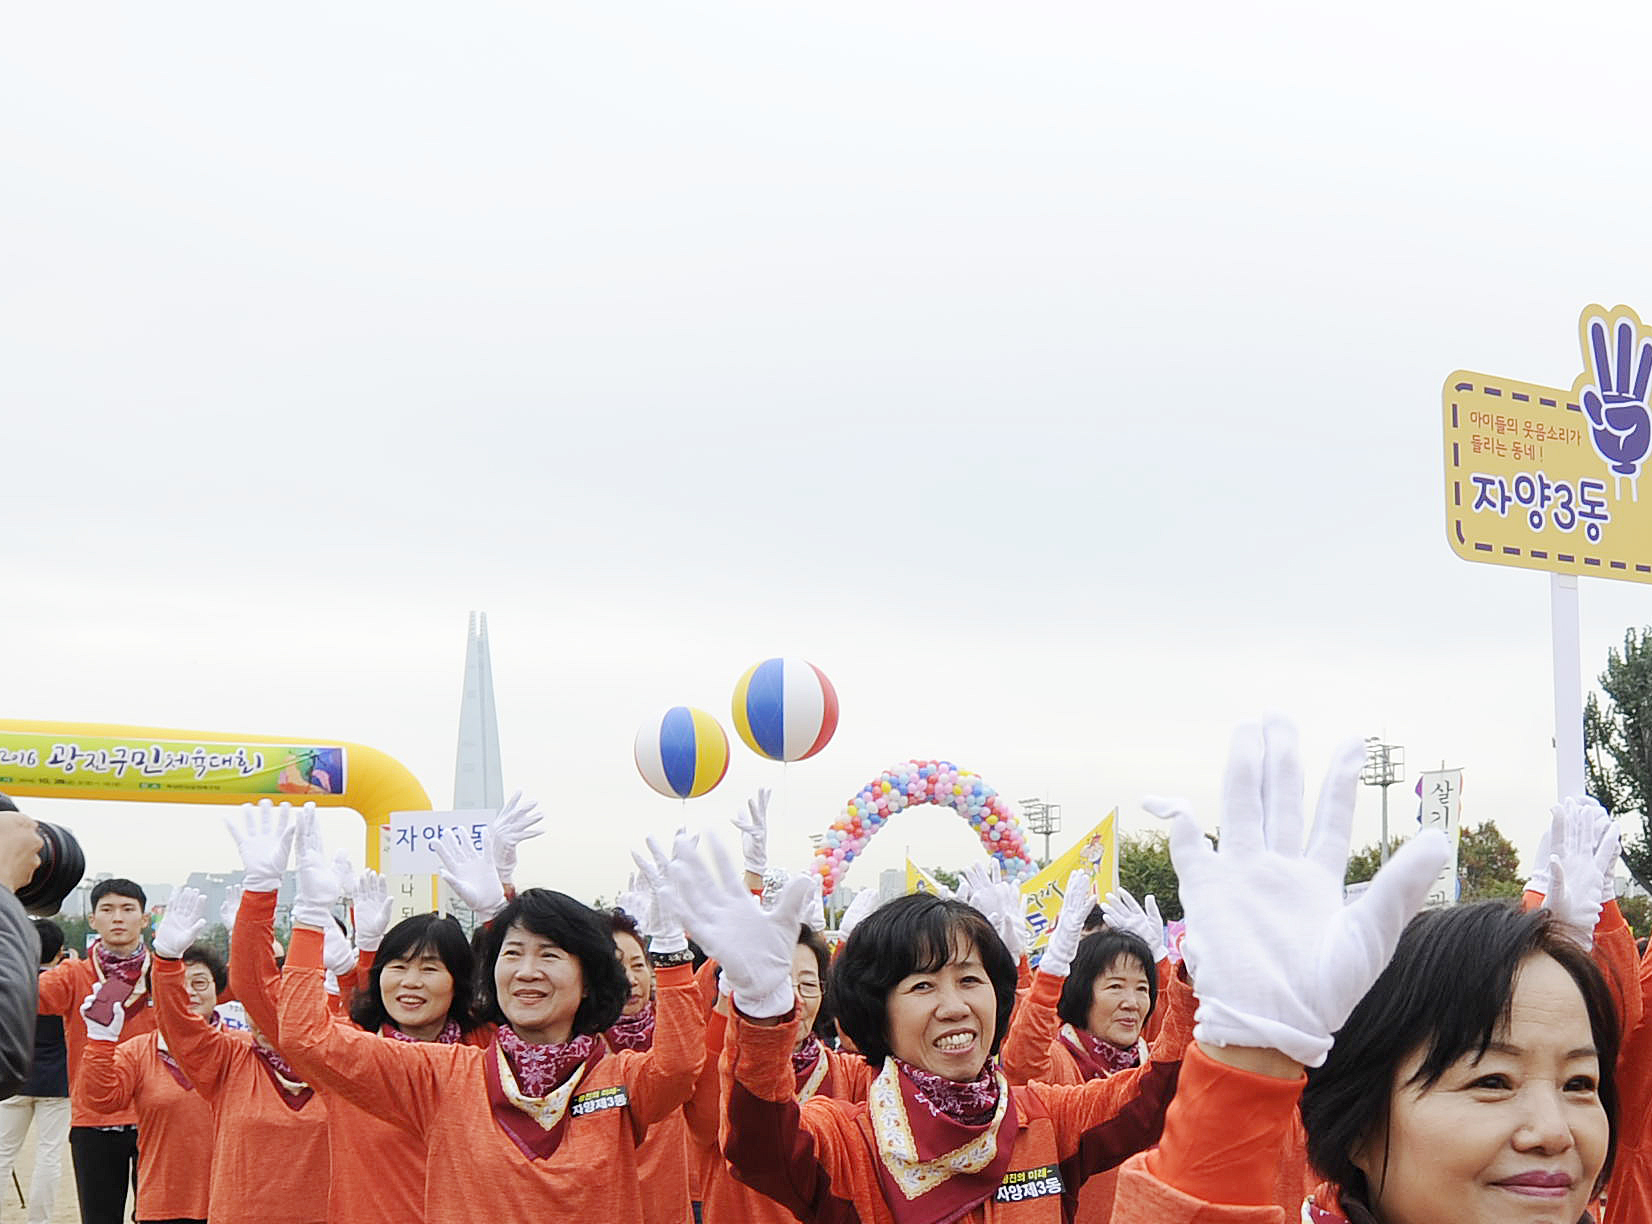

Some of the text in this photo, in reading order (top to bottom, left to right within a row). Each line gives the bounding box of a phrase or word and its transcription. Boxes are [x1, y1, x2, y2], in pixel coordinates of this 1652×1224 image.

[1469, 411, 1581, 447] 아이들의 웃음소리가
[1471, 434, 1508, 458] 들리는
[1471, 473, 1610, 542] 자양3동
[47, 744, 264, 779] 광진구민체육대회
